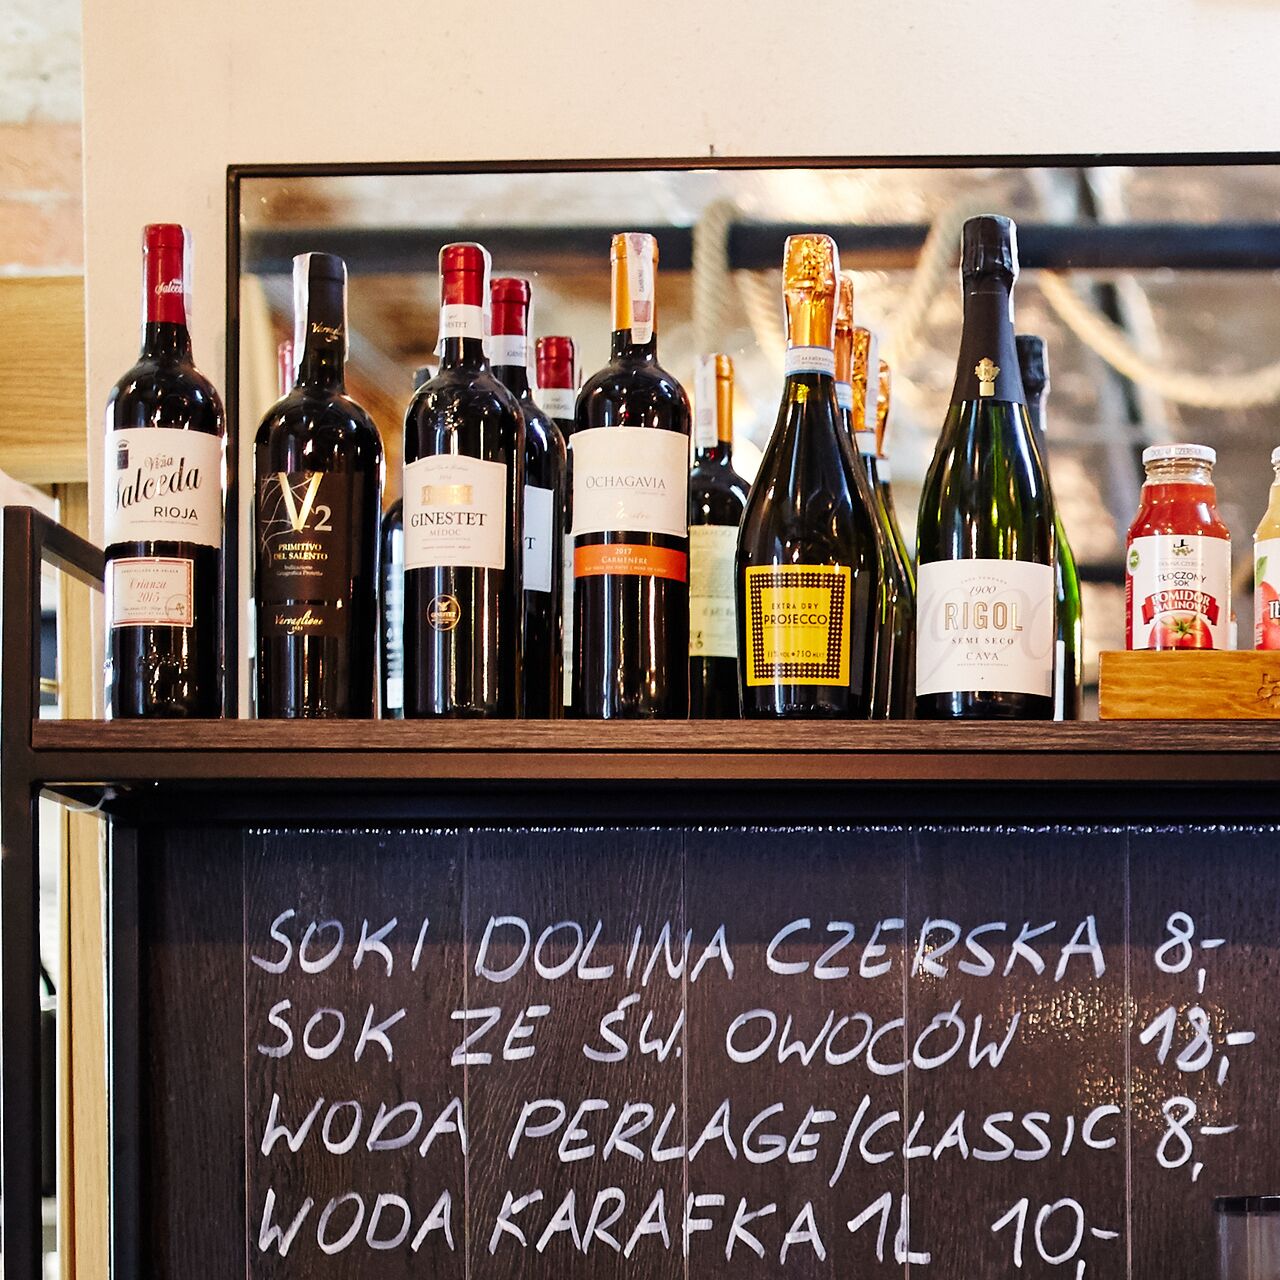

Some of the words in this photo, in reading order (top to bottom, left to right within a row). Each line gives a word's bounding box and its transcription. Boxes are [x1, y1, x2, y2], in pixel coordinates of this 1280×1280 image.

[114, 457, 203, 514] Salceda
[585, 475, 667, 490] OCHAGAVIA
[153, 506, 199, 521] RIOJA
[410, 511, 488, 528] GINESTET
[278, 542, 323, 552] PRIMITIVO
[614, 547, 633, 556] 2017
[273, 552, 288, 561] DEL
[288, 552, 329, 562] SALENTO
[129, 577, 168, 590] Crianza
[1173, 579, 1190, 587] SOK
[968, 585, 997, 597] 1900
[1151, 590, 1211, 606] POMIDOR
[764, 614, 828, 625] PROSECCO
[944, 601, 1024, 632] RIGOL
[951, 637, 979, 645] SEMI
[985, 637, 1015, 646] SECO
[966, 652, 1000, 661] CAVA
[251, 908, 430, 977] SOKI
[475, 914, 736, 987] DOLINA
[766, 914, 1107, 982] CZERSKA
[256, 999, 407, 1063] SOK
[450, 1003, 551, 1068] ZE
[725, 1000, 1022, 1075] OWOCÓW
[260, 1093, 470, 1159] WODA
[507, 1094, 1122, 1190] PERLAGE/CLASSIC
[257, 1186, 456, 1258] WODA
[488, 1187, 828, 1266] KARAFKA
[846, 1191, 932, 1266] 1L
